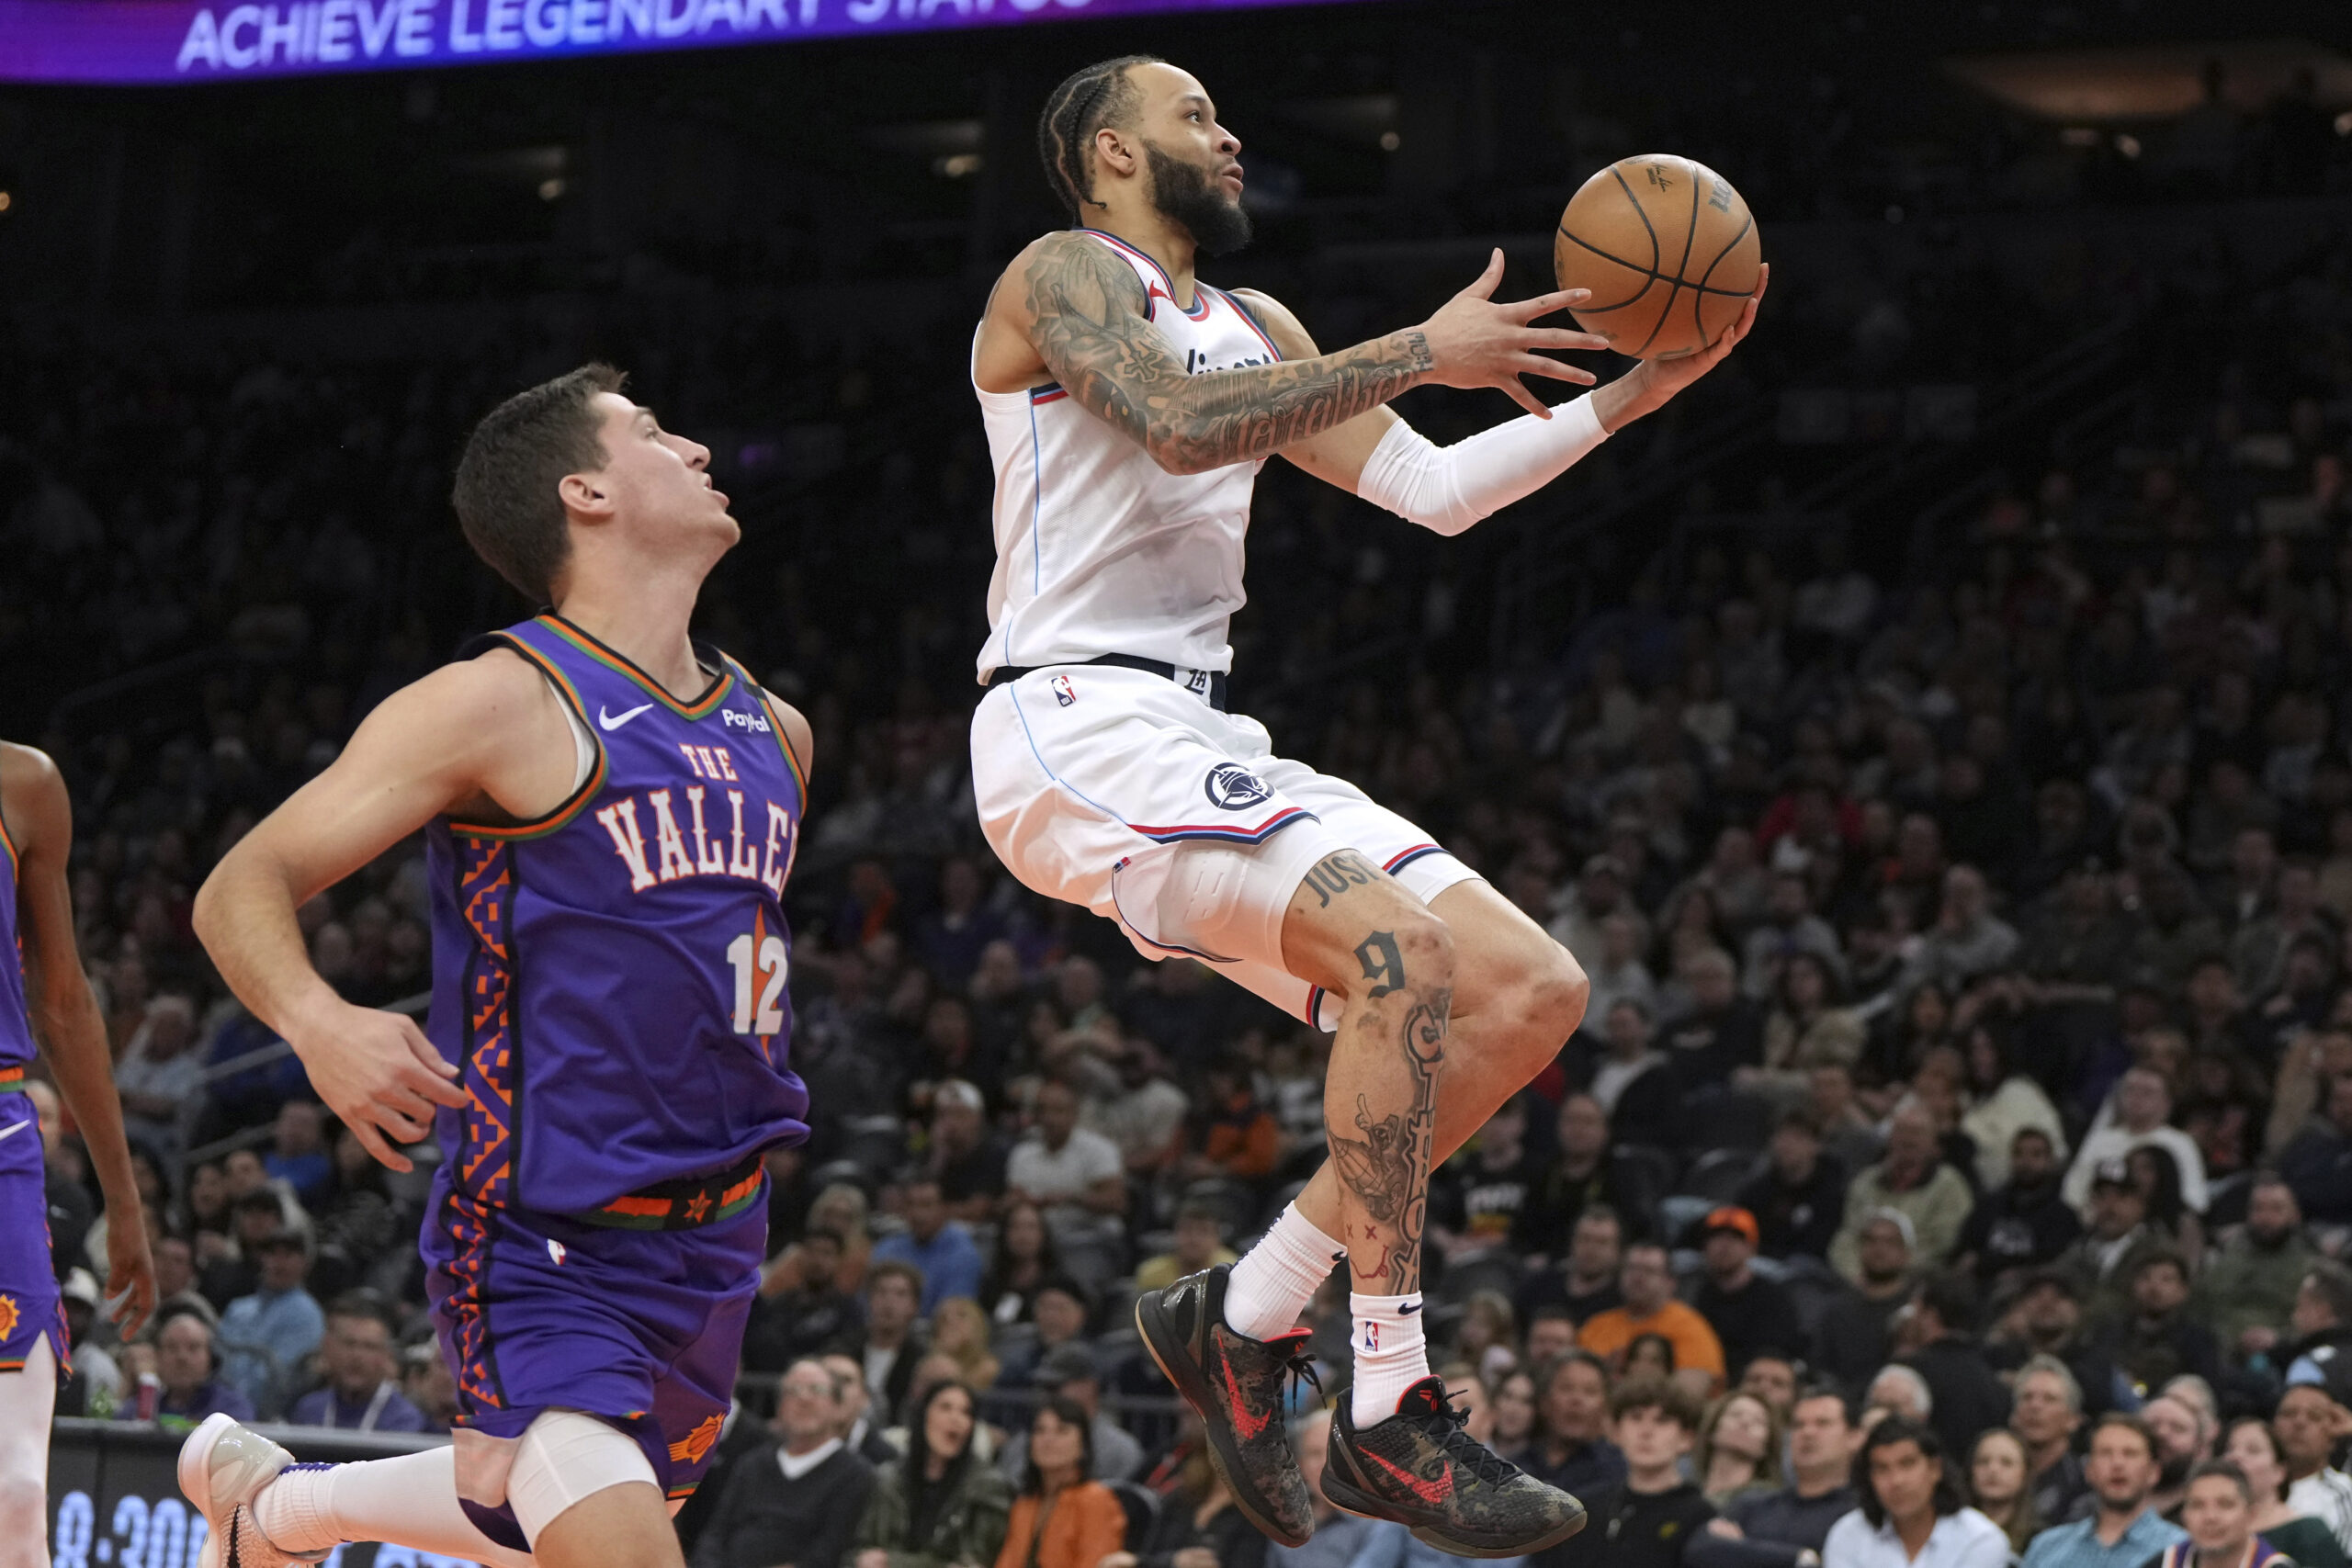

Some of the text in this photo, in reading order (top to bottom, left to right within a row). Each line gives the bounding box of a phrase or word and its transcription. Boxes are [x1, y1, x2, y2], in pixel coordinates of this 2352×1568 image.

[175, 0, 436, 73] ACHIEVE
[721, 708, 771, 733] PayPal
[678, 742, 740, 782] THE
[595, 784, 798, 903] VALLE
[726, 933, 788, 1035] 12
